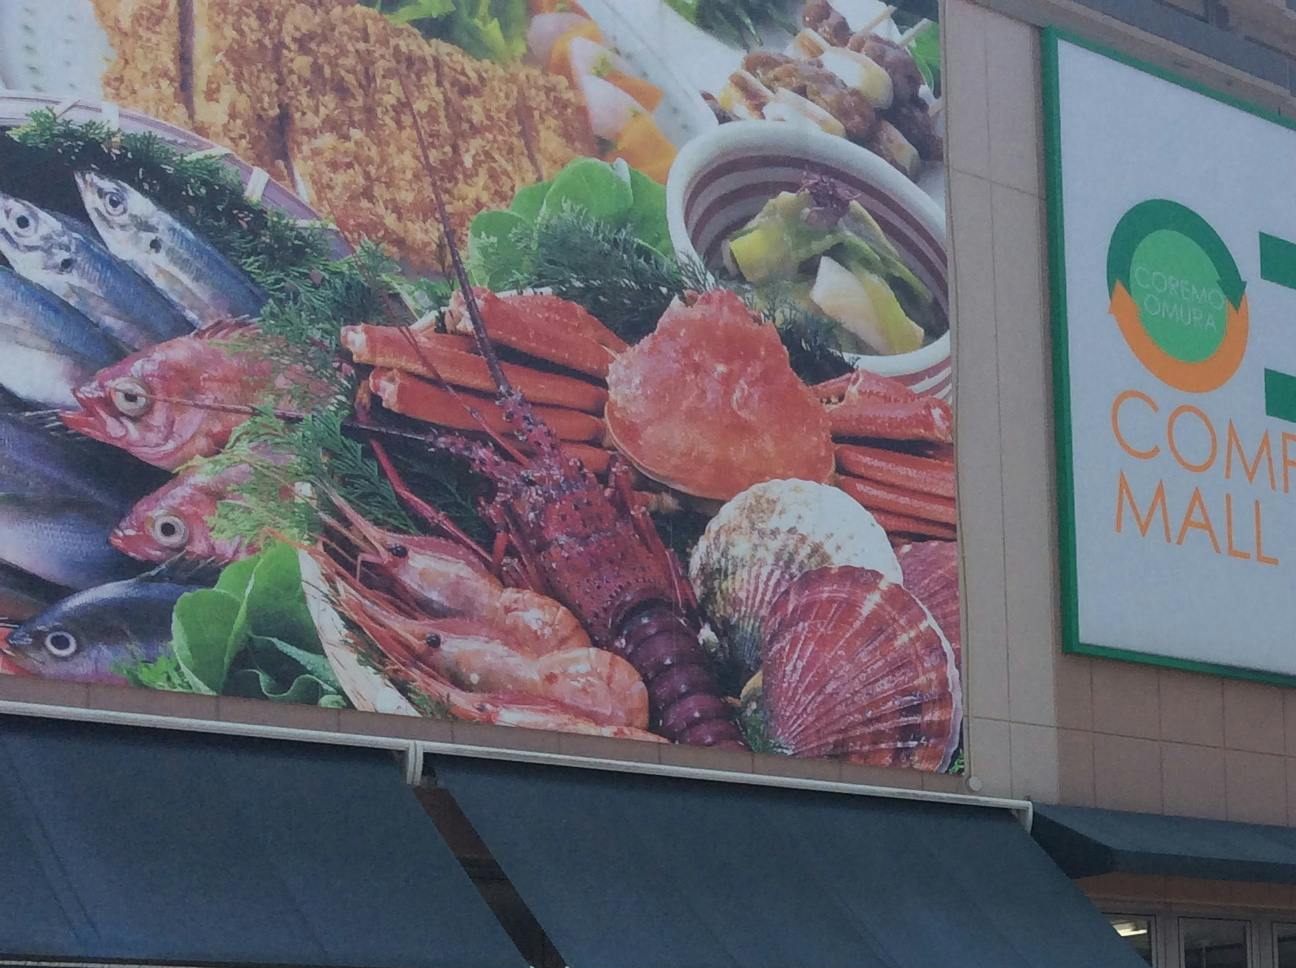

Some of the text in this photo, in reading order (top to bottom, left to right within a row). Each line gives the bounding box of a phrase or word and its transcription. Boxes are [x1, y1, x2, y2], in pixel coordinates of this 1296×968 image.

[1134, 266, 1224, 310] COREMO
[1143, 294, 1217, 332] OMURA
[1114, 469, 1279, 567] MALL
